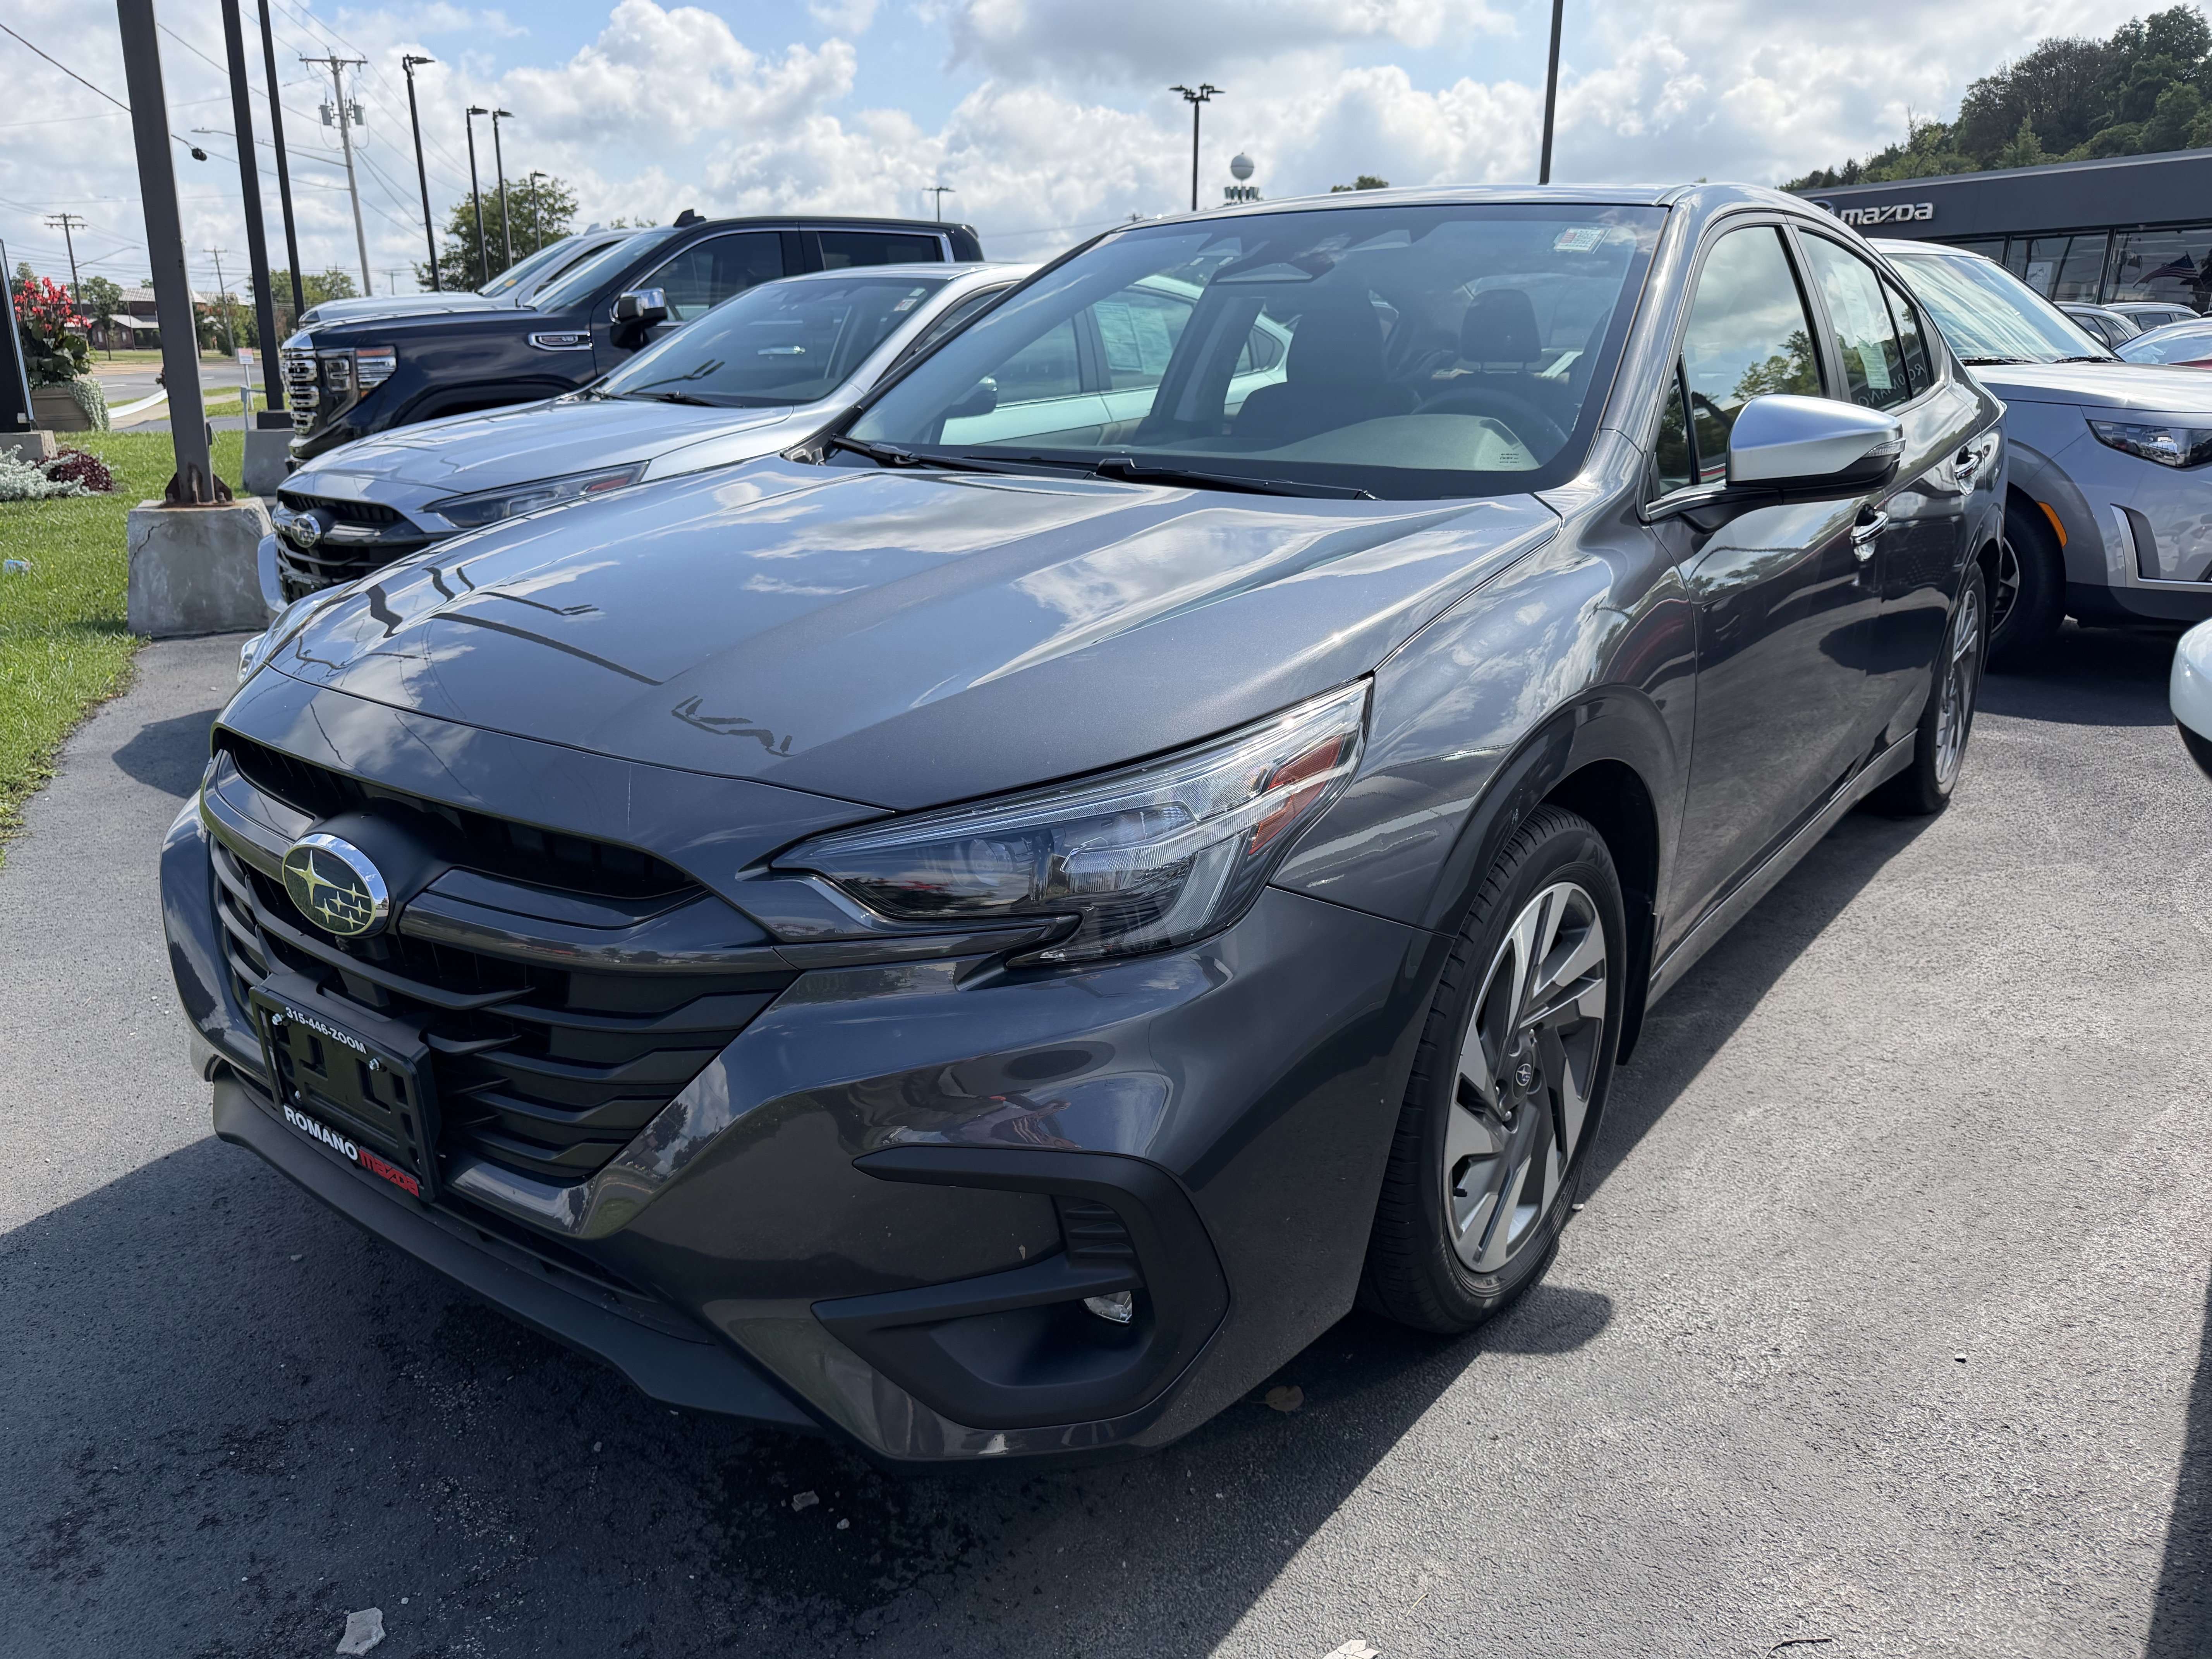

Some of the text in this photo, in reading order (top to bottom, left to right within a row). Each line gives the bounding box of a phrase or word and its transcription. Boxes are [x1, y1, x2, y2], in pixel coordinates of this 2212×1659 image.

[1840, 202, 1934, 226] mazda
[285, 1007, 367, 1054] 315-446-ZOOM
[283, 1104, 419, 1197] ROMANO mazda
